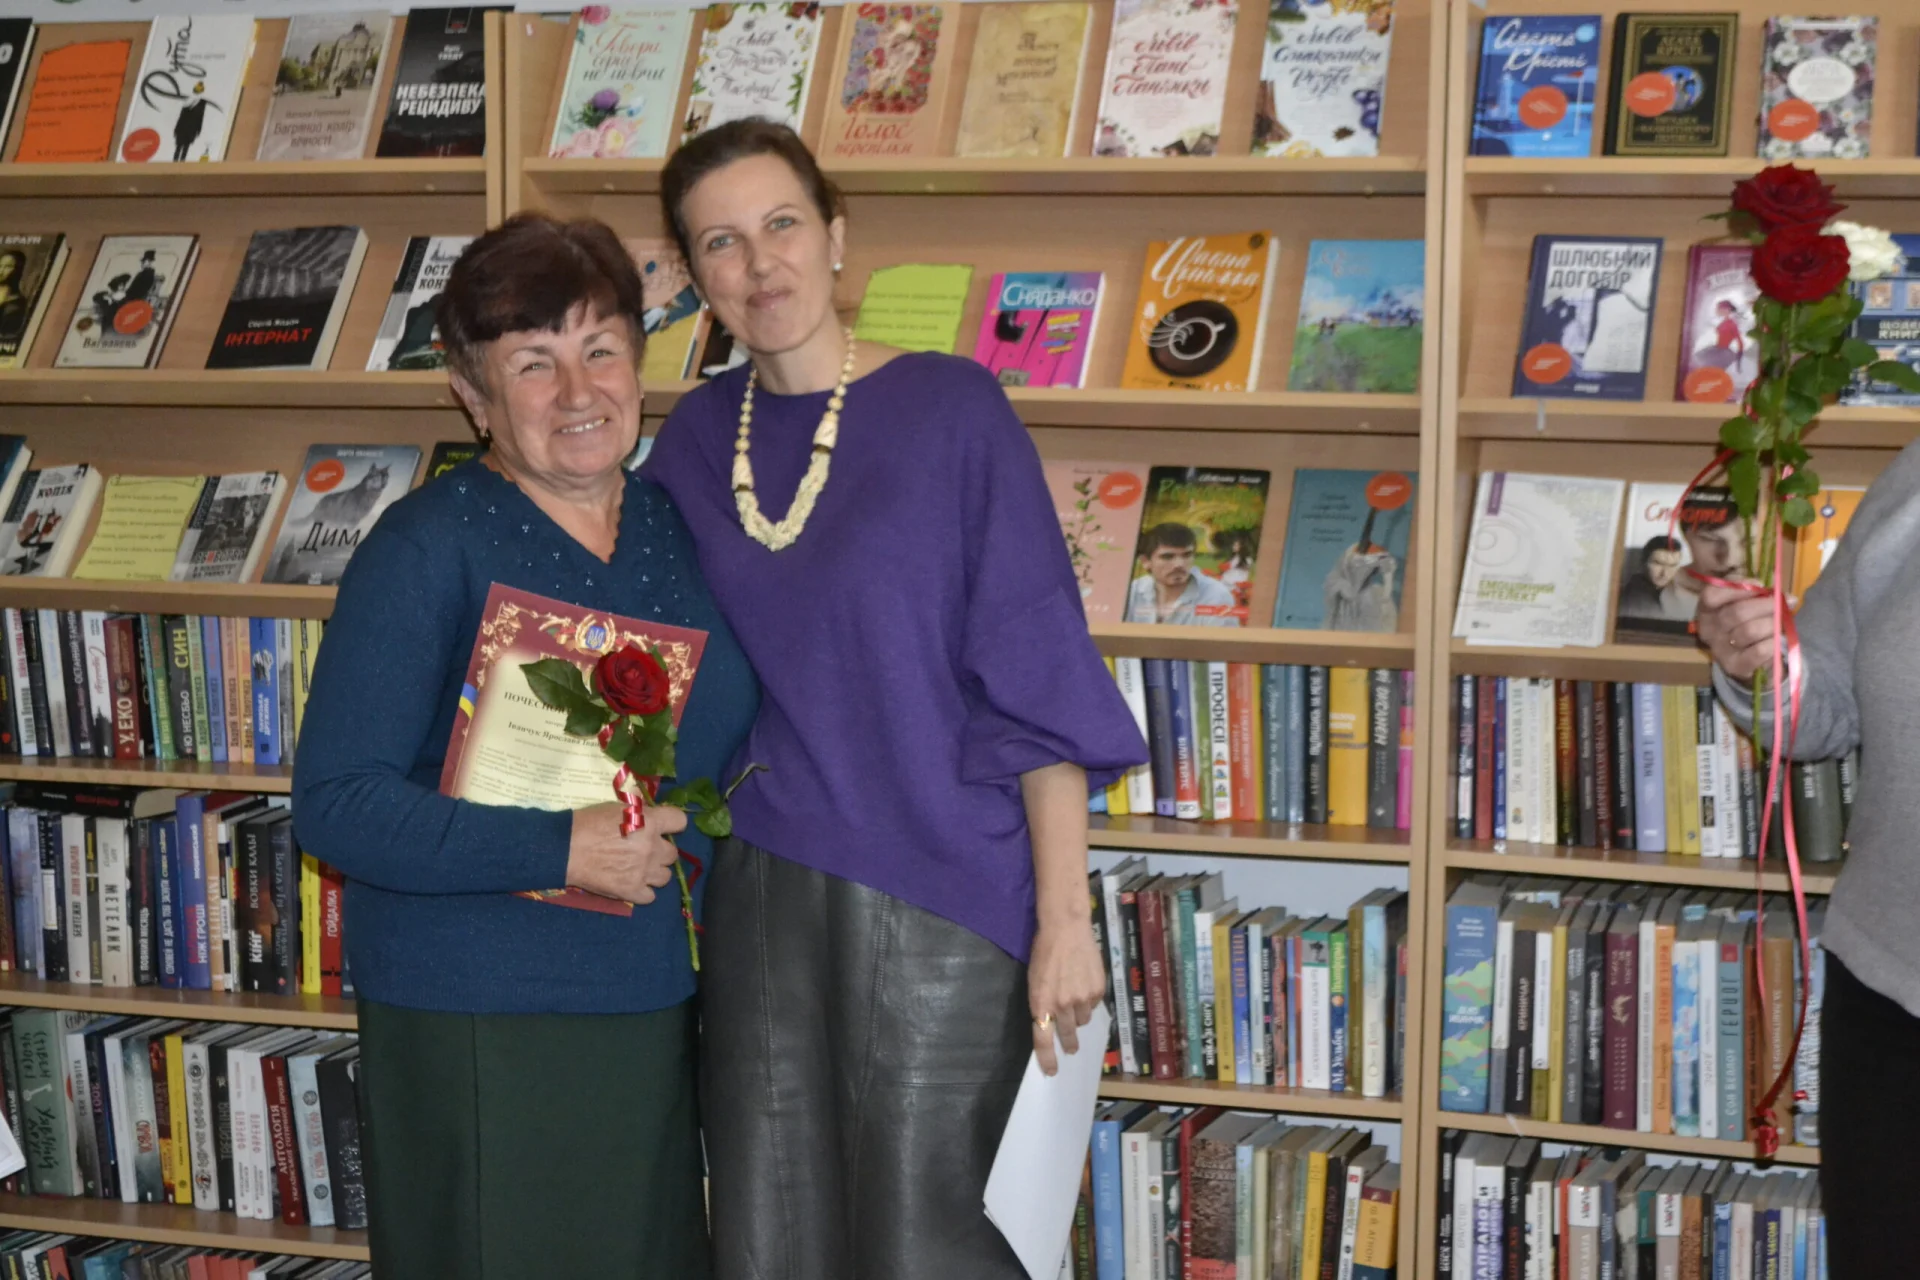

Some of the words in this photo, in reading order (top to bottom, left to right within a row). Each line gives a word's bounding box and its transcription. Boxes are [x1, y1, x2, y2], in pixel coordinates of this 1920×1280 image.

[396, 81, 486, 101] НЕБЕЗПЕКА
[398, 100, 482, 118] РЕЦИДИВУ
[1549, 269, 1632, 289] ДОГОВІР
[1551, 249, 1651, 268] ШЛЮБНИЙ
[224, 328, 313, 348] ІНТЕРНАТ
[172, 628, 190, 669] СИН
[116, 697, 134, 731] ЕКО
[180, 690, 193, 734] НЕСБЬО
[507, 721, 541, 737] Іванчук
[541, 731, 583, 746] Ярослава
[104, 884, 121, 953] МЕТЕЛИК
[326, 889, 338, 938] ГОЙДАЛКА
[1517, 976, 1530, 1032] КРИНИЧАР
[36, 1105, 57, 1170] УЯВНИЙ
[270, 1104, 288, 1175] АНТОЛОГІЯ
[1476, 1185, 1489, 1280] АПРАНОВИ
